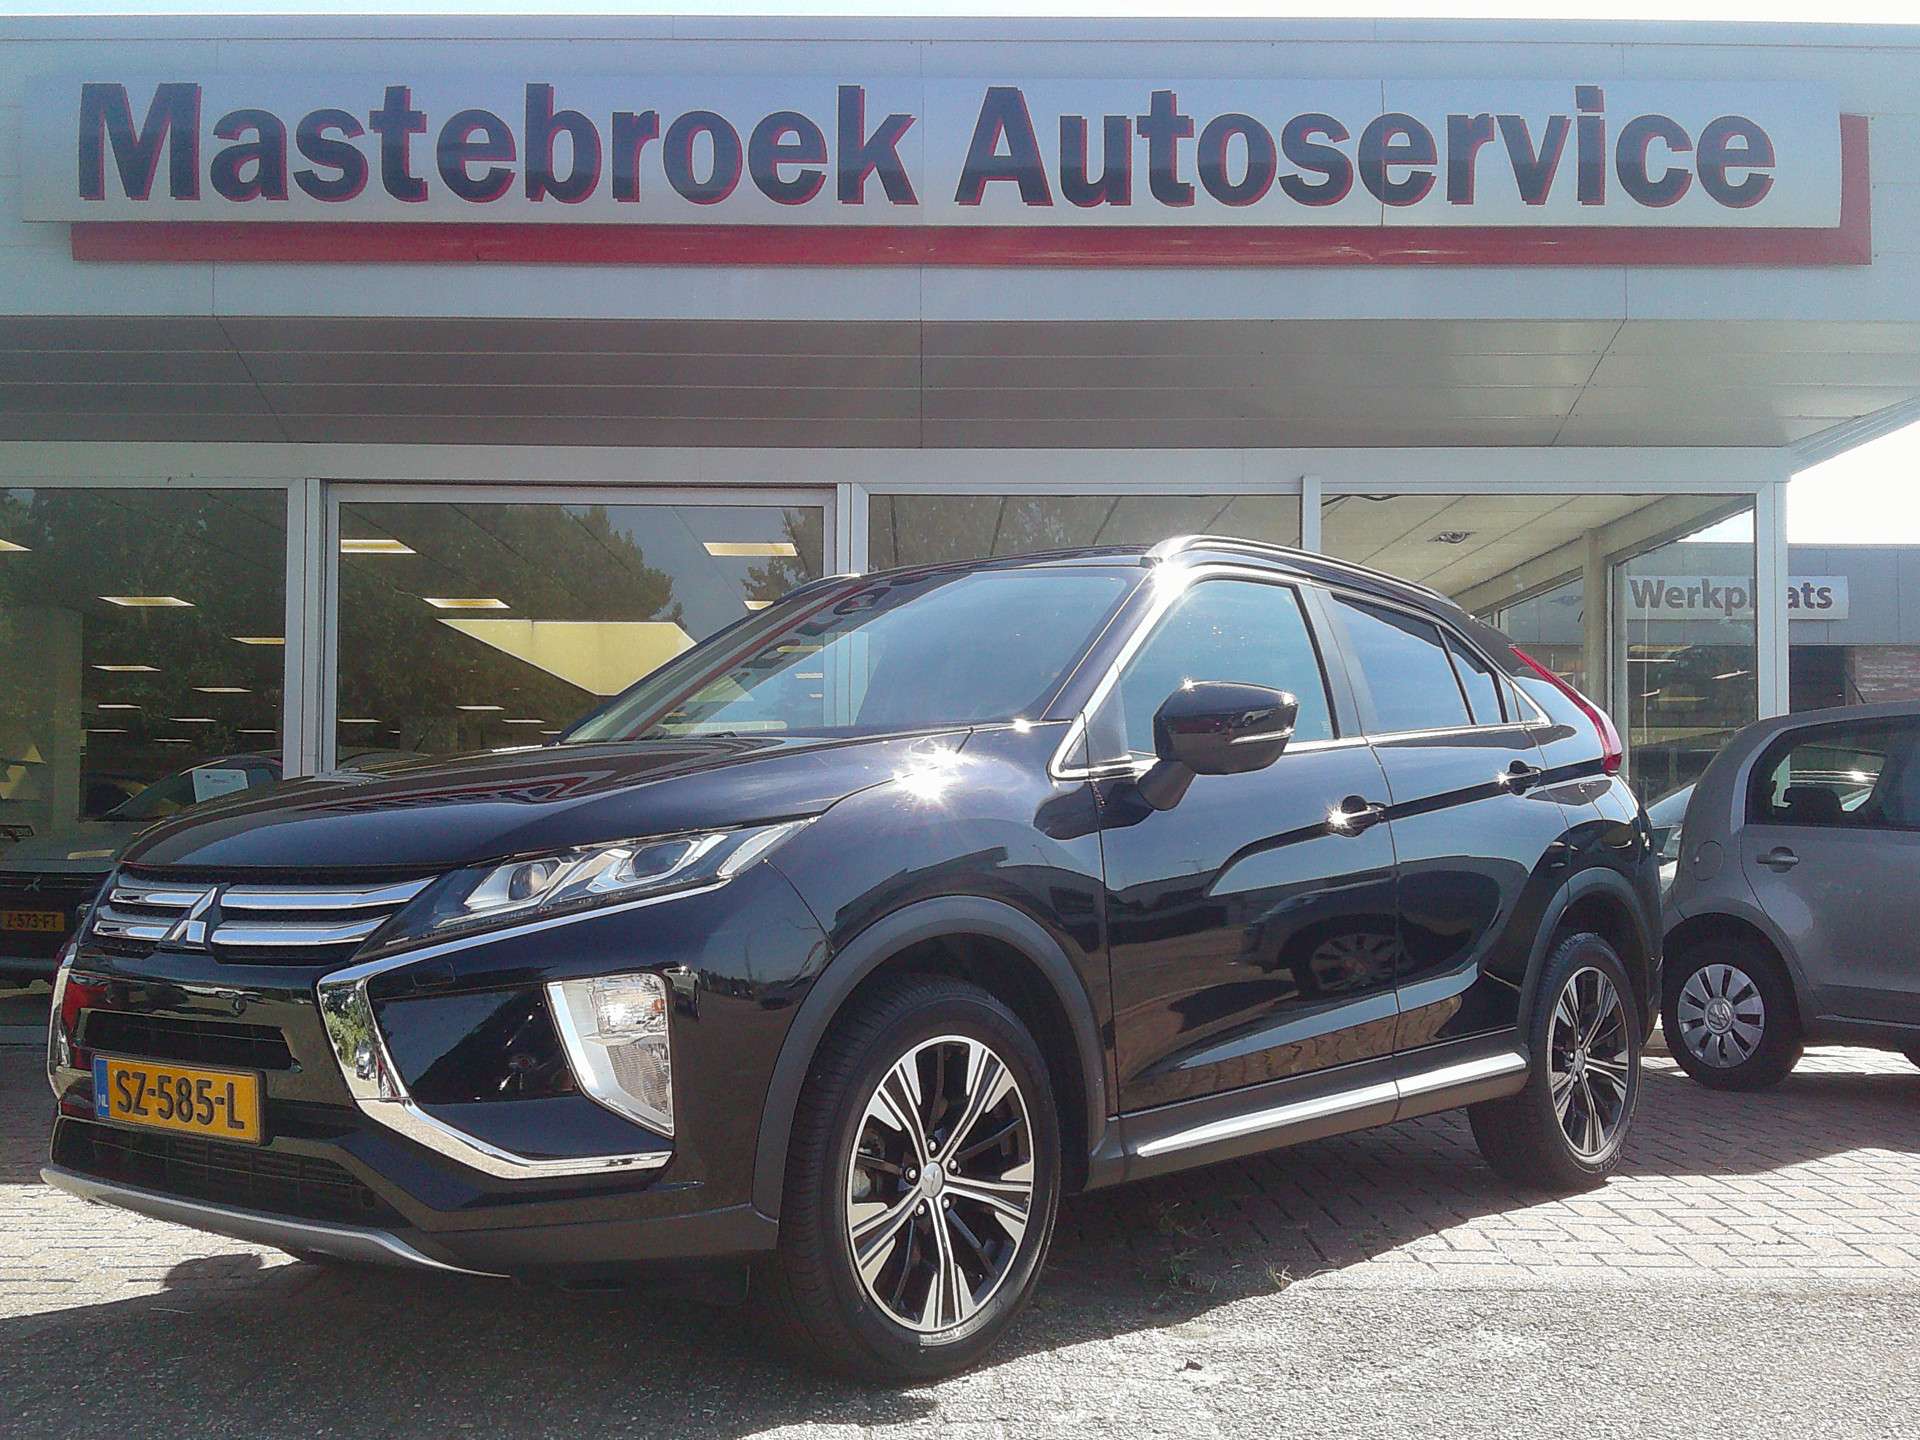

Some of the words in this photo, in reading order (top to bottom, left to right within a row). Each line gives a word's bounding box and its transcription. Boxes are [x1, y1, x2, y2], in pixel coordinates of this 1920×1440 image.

[79, 82, 918, 204] Mastebroek
[955, 86, 1776, 207] Autoservice
[1629, 577, 1833, 616] Werkplats
[115, 1070, 245, 1130] SZ-585-L
